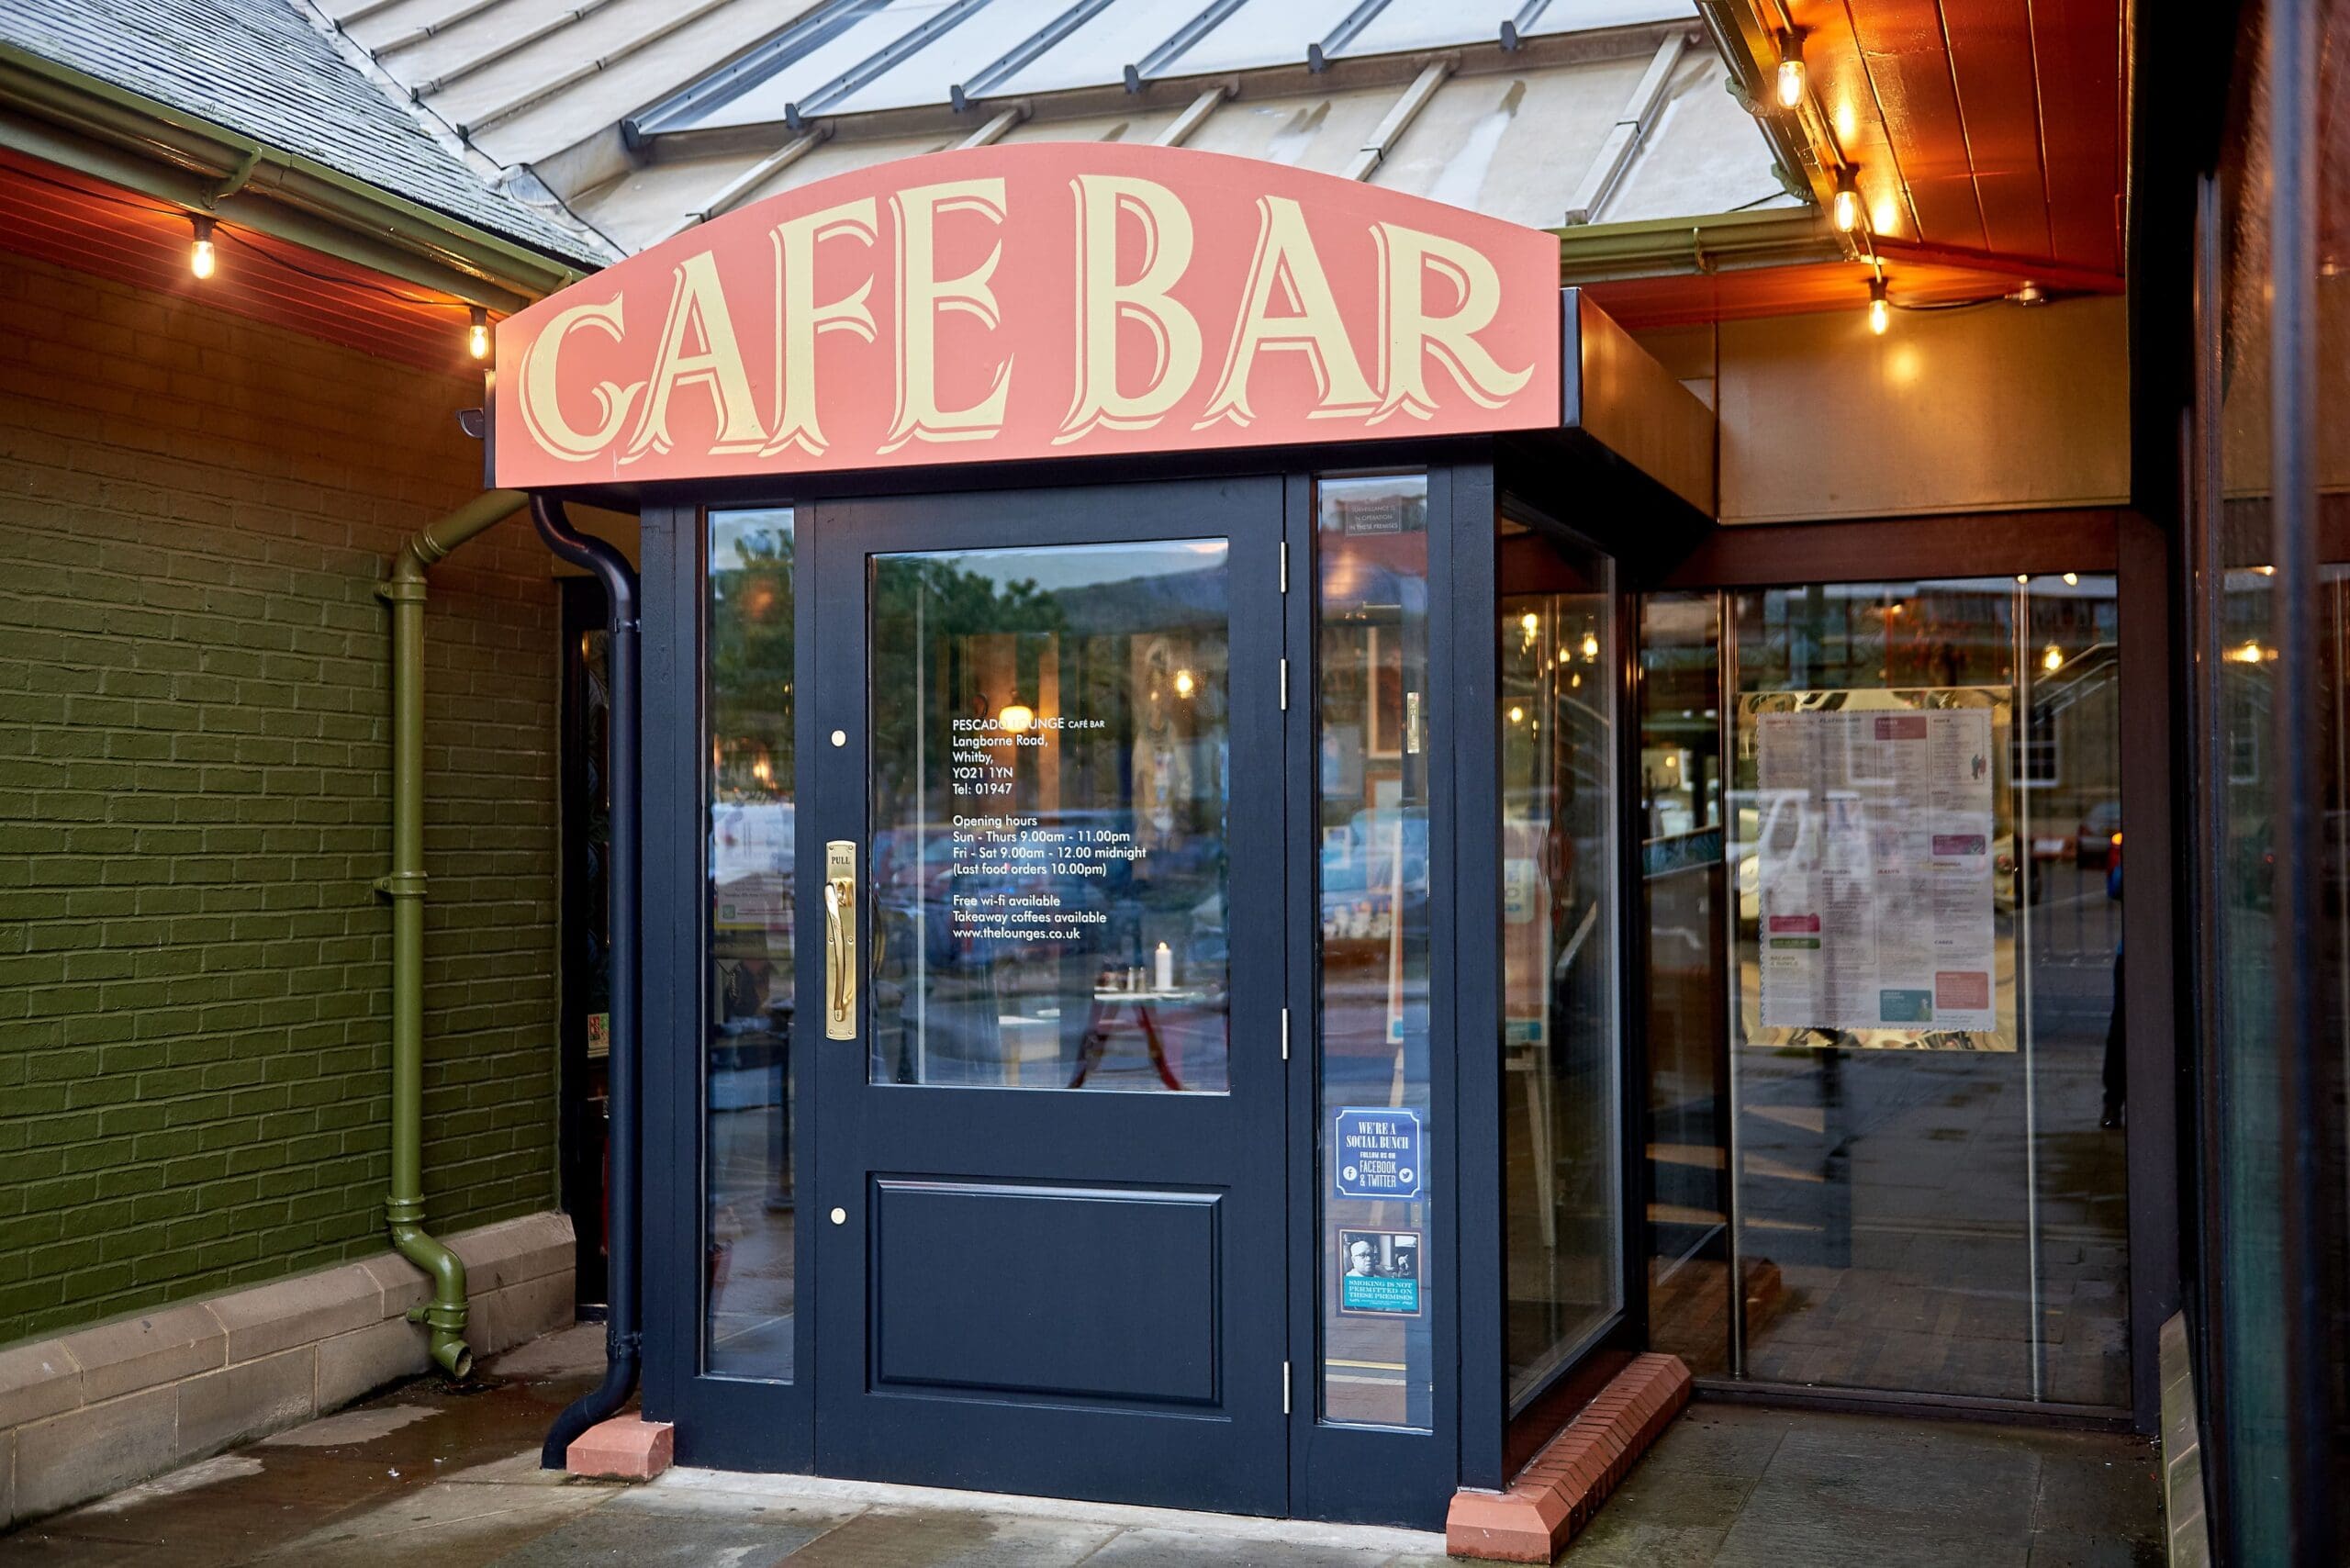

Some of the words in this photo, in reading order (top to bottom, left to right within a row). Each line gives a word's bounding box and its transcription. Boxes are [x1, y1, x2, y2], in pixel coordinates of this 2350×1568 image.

[519, 177, 1013, 463] CAFE
[1051, 174, 1535, 445] BAR
[1068, 719, 1088, 729] CAFÉ
[1090, 720, 1105, 728] BAR
[953, 735, 1013, 749] Langborne
[1016, 734, 1048, 747] Road,
[952, 751, 993, 765] Whitby,
[952, 767, 984, 778] YO21
[989, 767, 1013, 778] 1YN
[952, 783, 971, 795] Tel:
[975, 782, 1013, 795] 01947
[953, 814, 1002, 829] Opening
[1005, 813, 1037, 826] hours
[953, 831, 974, 842] Sun
[986, 831, 1016, 842] Thurs
[1020, 830, 1065, 842] 9.00am
[1078, 830, 1130, 845] 11.00pm
[953, 846, 967, 858] Fri
[979, 846, 997, 858] Sat
[1000, 846, 1045, 858] 9.00am
[1058, 846, 1091, 858] 12.00
[1095, 846, 1147, 860] midnight
[831, 856, 851, 865] PULL
[953, 863, 979, 877] (Last
[981, 862, 1007, 874] food
[1011, 863, 1046, 875] orders
[1051, 863, 1107, 878] 10.00pm)
[953, 894, 978, 906] Free
[980, 894, 1006, 906] wi-fi
[1009, 895, 1061, 906] available
[953, 911, 1008, 924] Takeaway
[1011, 911, 1051, 923] coffees
[1055, 912, 1107, 924] available
[953, 927, 1081, 941] www.thelounges.co.uk
[1359, 1122, 1388, 1135] WE'RE
[1390, 1122, 1396, 1135] A
[1346, 1135, 1378, 1148] SOCIAL
[1380, 1137, 1409, 1148] BUNCH
[1360, 1160, 1396, 1174] FACEBOOK
[1360, 1174, 1366, 1187] &
[1368, 1174, 1396, 1187] TWITTER
[1348, 1285, 1398, 1294] PERMITTED
[1374, 1293, 1413, 1301] PREMISES
